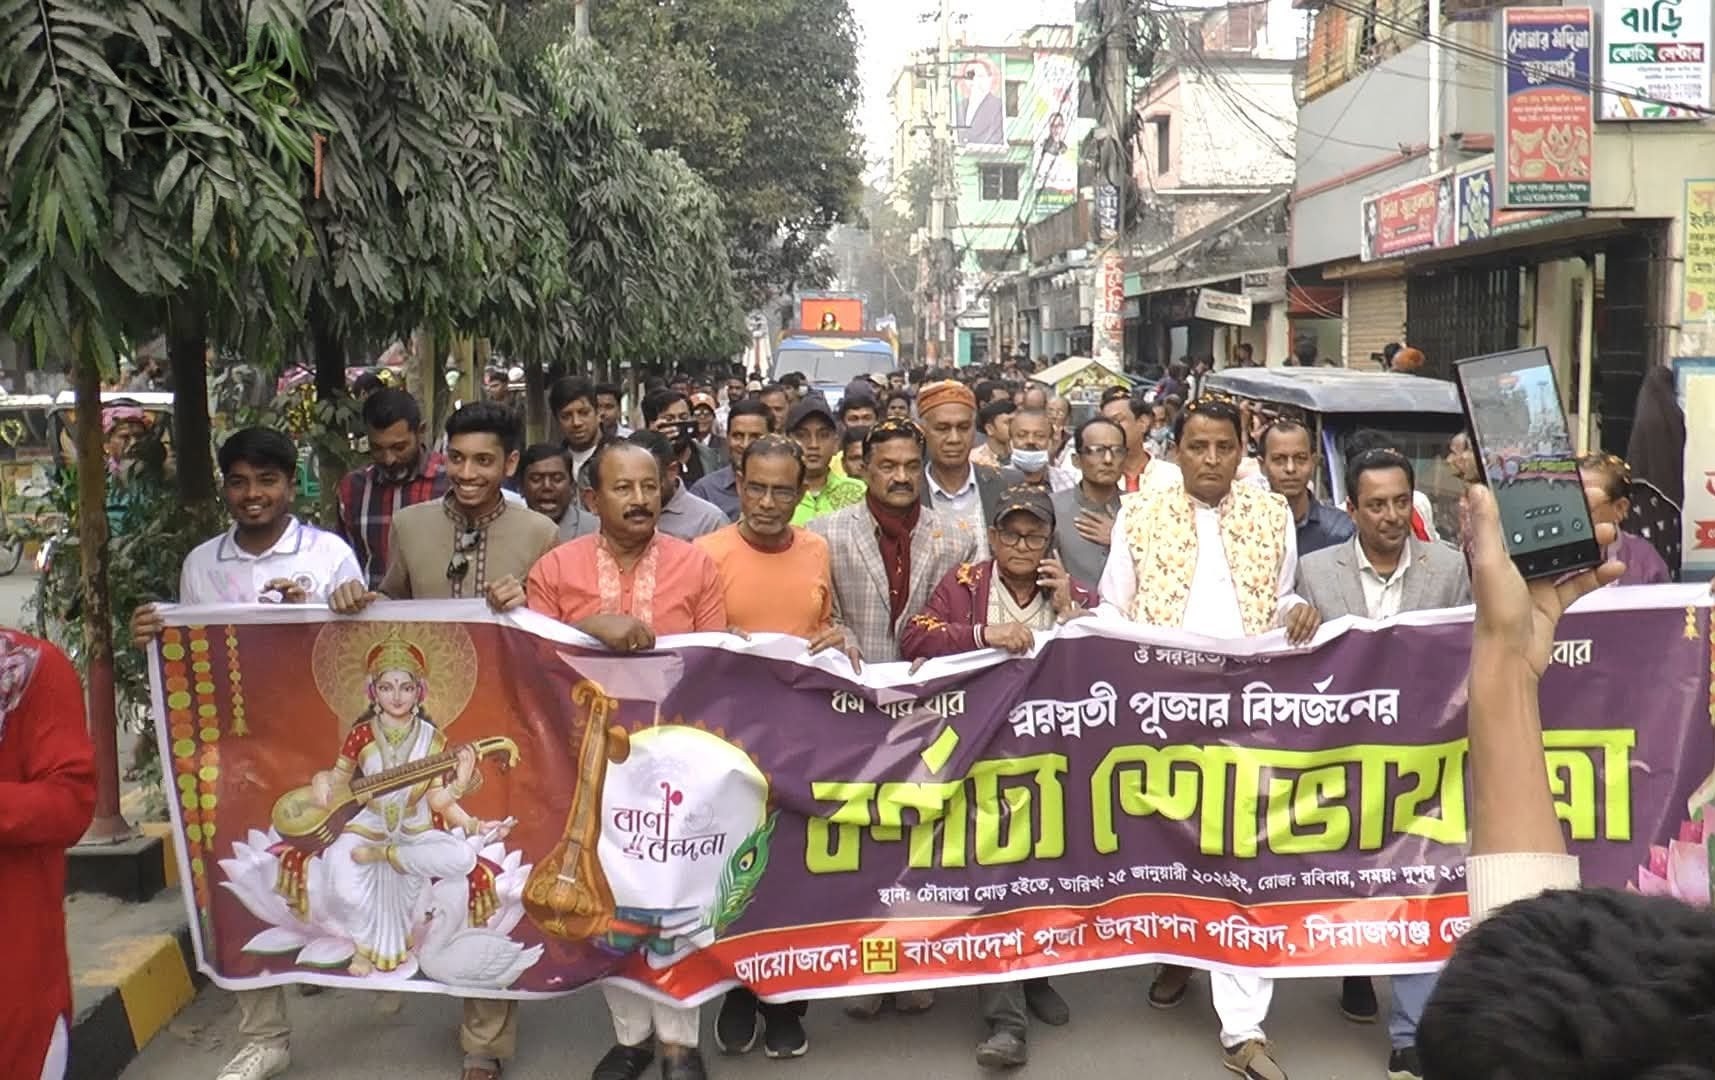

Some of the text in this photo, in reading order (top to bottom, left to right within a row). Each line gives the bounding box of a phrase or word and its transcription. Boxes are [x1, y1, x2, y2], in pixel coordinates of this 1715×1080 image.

[1621, 0, 1682, 38] বাড়ি
[1548, 638, 1592, 667] বার
[1129, 689, 1230, 740] পূজার
[1242, 675, 1400, 729] বিসর্জনের
[974, 884, 1007, 901] মোড়
[1010, 876, 1054, 894] হইতে,
[1108, 869, 1127, 886] ২৫
[1301, 868, 1355, 888] রবিবার,
[1402, 864, 1435, 884] দুপুর
[904, 929, 1023, 967] বাংলাদেশ
[1033, 923, 1086, 958] পূজা
[1206, 915, 1297, 956] পরিষদ,
[1306, 915, 1431, 951] সিরাজগঞ্জ
